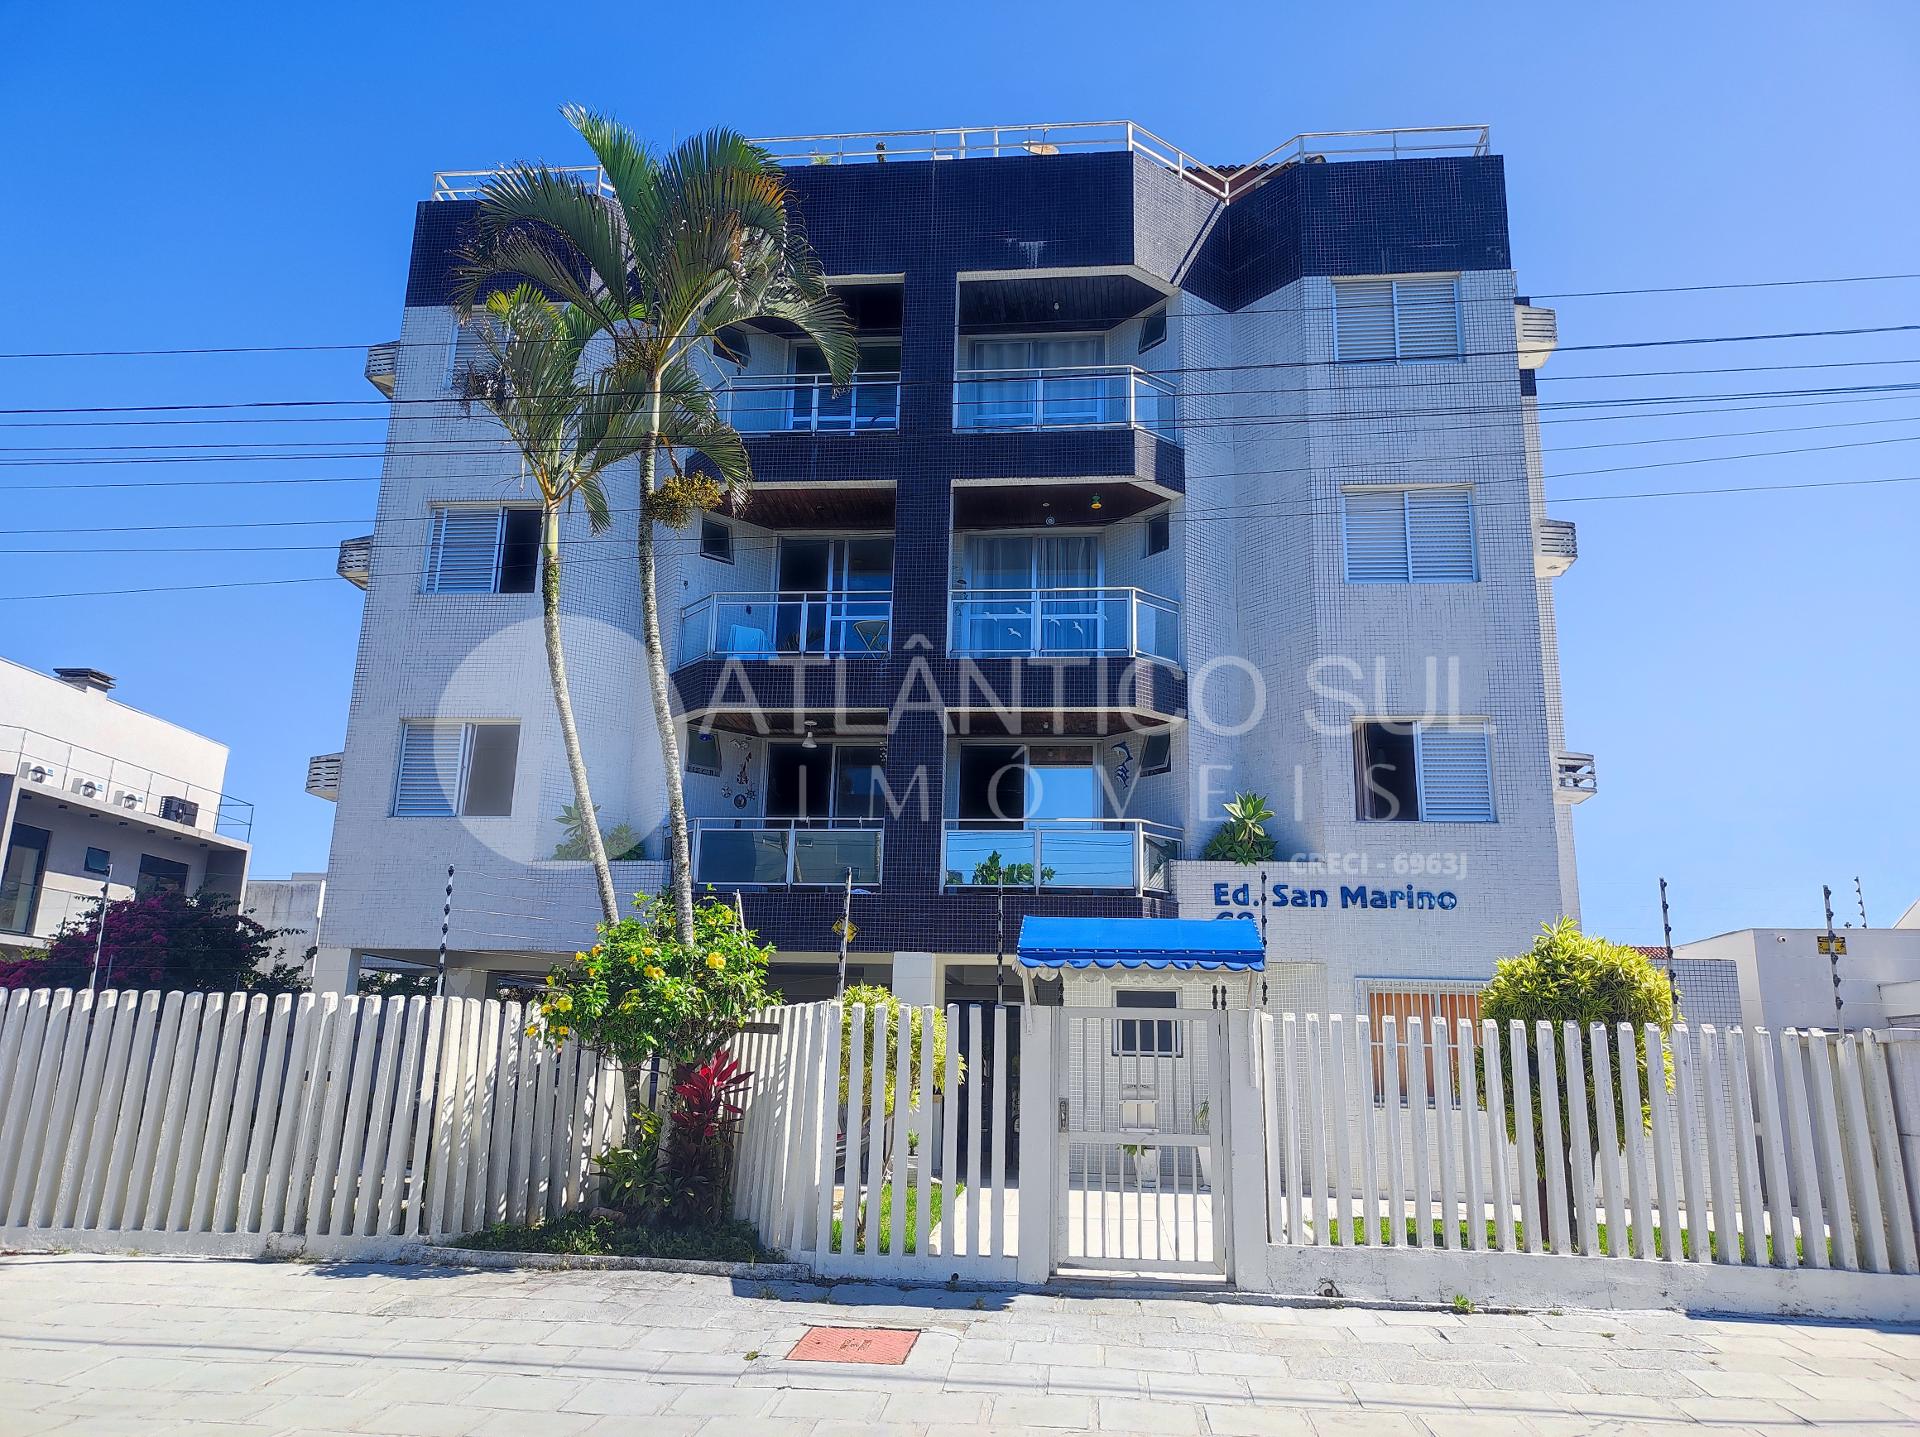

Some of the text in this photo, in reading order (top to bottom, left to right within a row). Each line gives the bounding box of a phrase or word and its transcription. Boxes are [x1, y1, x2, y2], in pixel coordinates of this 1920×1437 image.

[1213, 882, 1458, 911] Ed. San Marino
